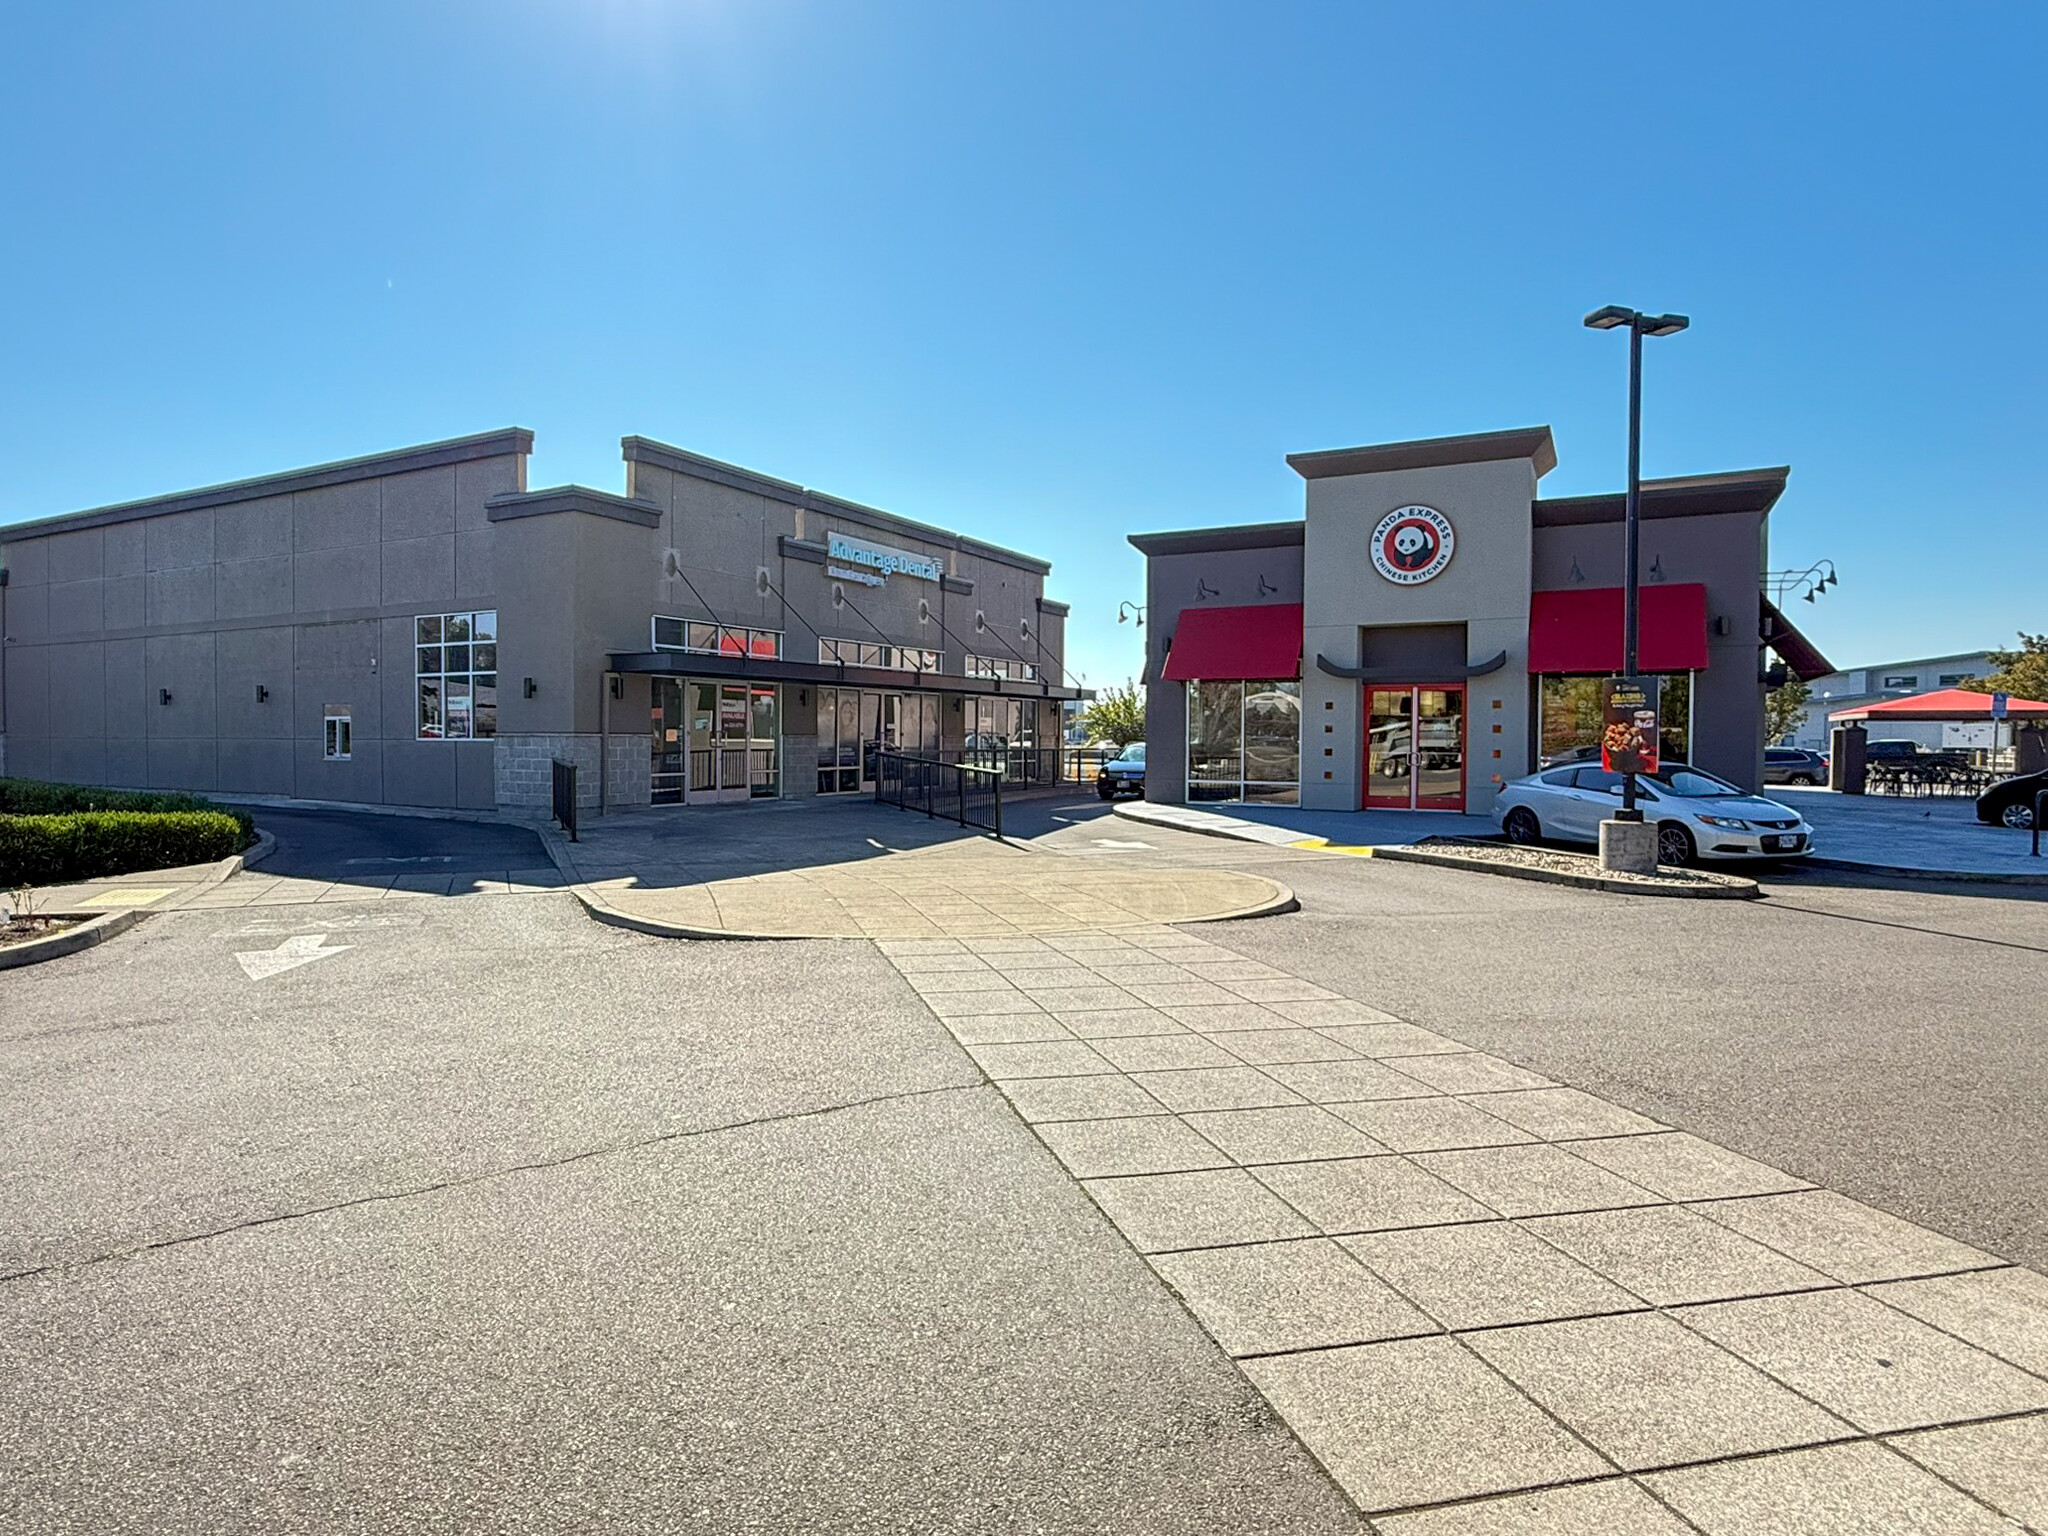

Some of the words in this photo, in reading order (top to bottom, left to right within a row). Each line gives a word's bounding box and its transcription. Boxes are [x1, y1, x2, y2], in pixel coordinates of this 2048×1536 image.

[1374, 511, 1405, 543] PANDA
[1408, 507, 1451, 540] EXPRESS
[830, 539, 898, 575] Advantage
[900, 556, 937, 579] Dental
[1376, 556, 1408, 581] CHINESE
[1412, 554, 1447, 581] KITCHEN
